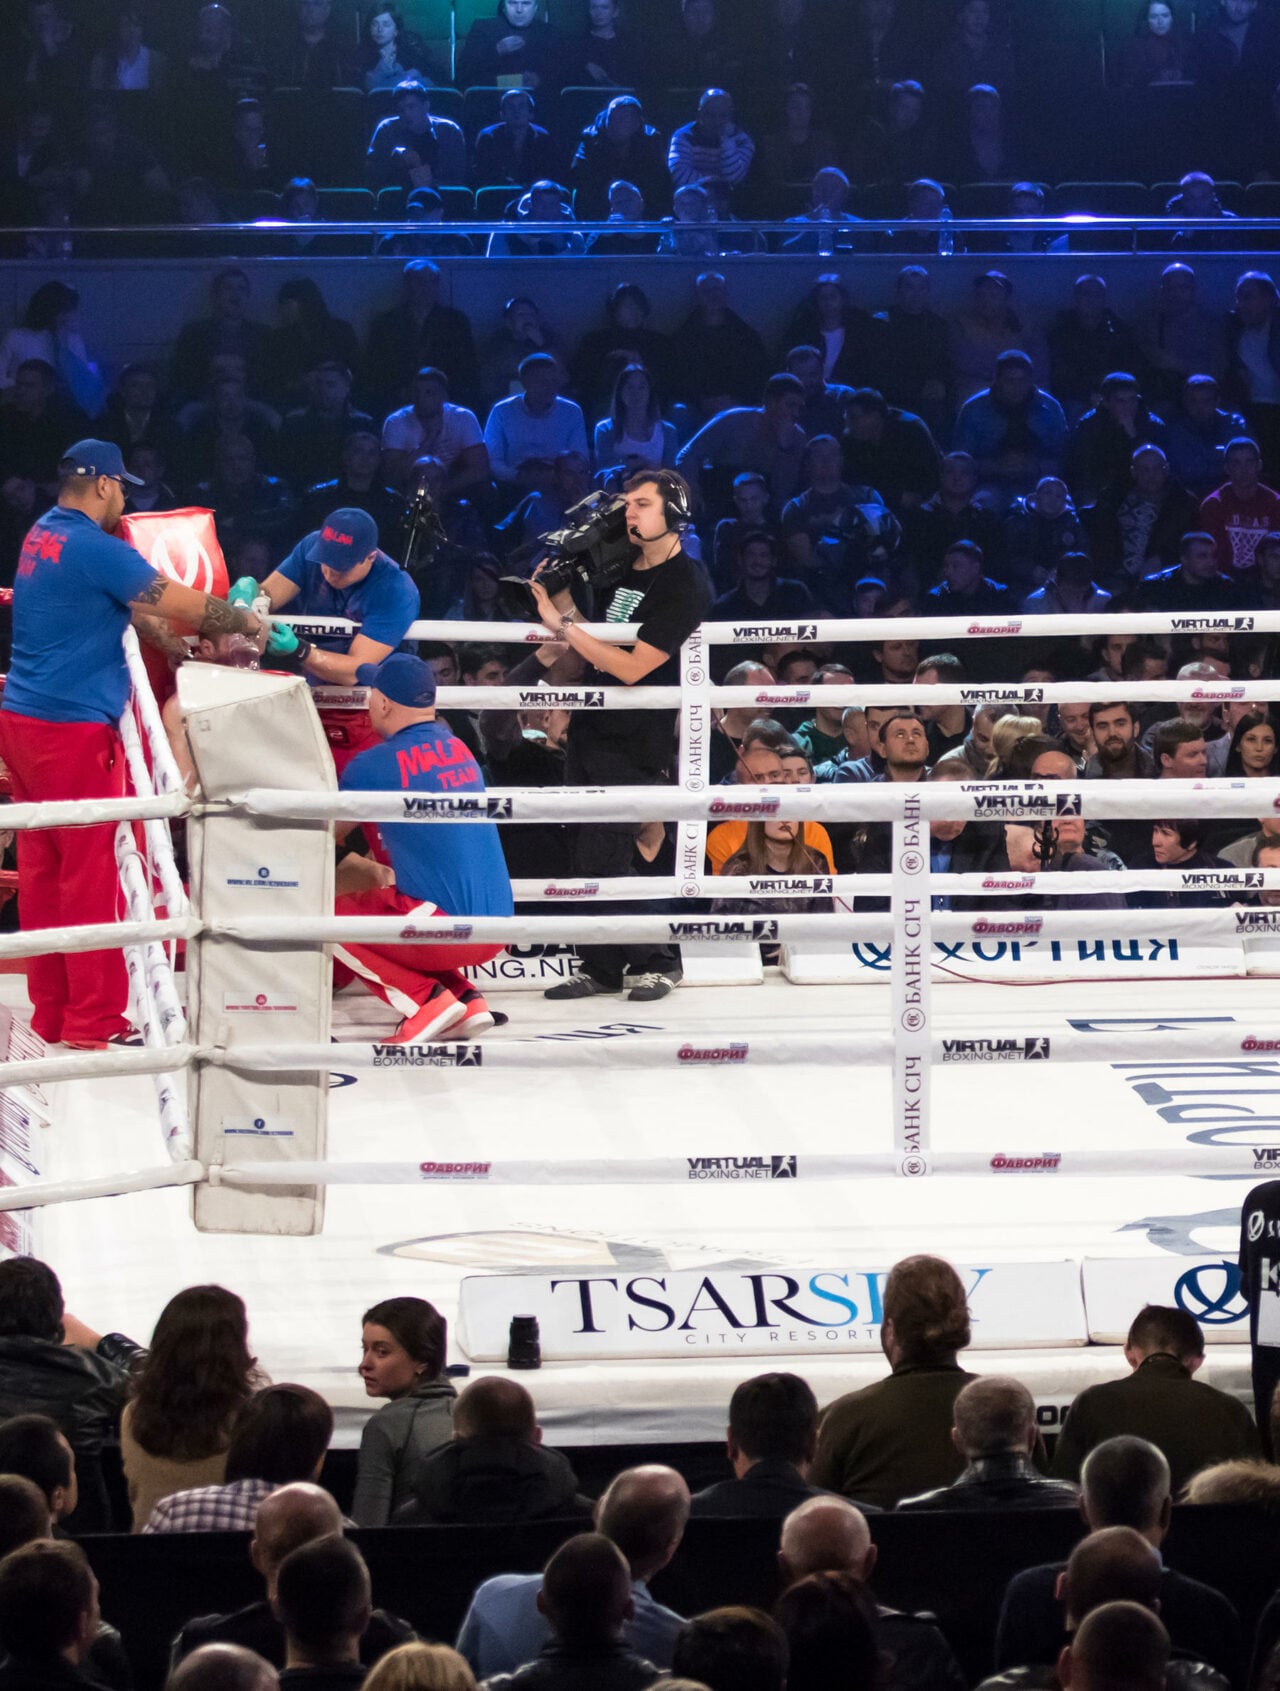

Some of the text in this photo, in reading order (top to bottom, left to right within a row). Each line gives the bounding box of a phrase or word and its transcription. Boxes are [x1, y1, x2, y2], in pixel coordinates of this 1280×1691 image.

[1171, 618, 1234, 629] VIRTUAL
[733, 626, 797, 637] VIRTUAL
[688, 627, 702, 664] БАН
[519, 692, 584, 702] VIRTUAL
[960, 690, 1024, 700] VIRTUAL
[688, 736, 703, 777] БАНК
[403, 797, 487, 811] VIRTUAL
[974, 794, 1056, 809] VIRTUAL
[403, 809, 487, 818] BOXING.NET
[974, 807, 1055, 817] BOXING.NET
[904, 792, 922, 847] БАНК
[684, 845, 698, 880] БАНК
[750, 879, 813, 891] VIRTUAL
[1182, 873, 1245, 885] VIRTUAL
[669, 921, 753, 936] VIRTUAL
[904, 899, 922, 1004] БАНК СІЧ
[372, 1044, 456, 1058] VIRTUAL
[942, 1039, 1025, 1053] VIRTUAL
[373, 1057, 456, 1067] BOXING.NET
[942, 1051, 1025, 1062] BOXING.NET
[904, 1056, 922, 1093] СІЧ
[688, 1156, 771, 1170] VIRTUAL
[689, 1168, 771, 1179] BOXING.NET
[685, 1333, 748, 1345] CITY
